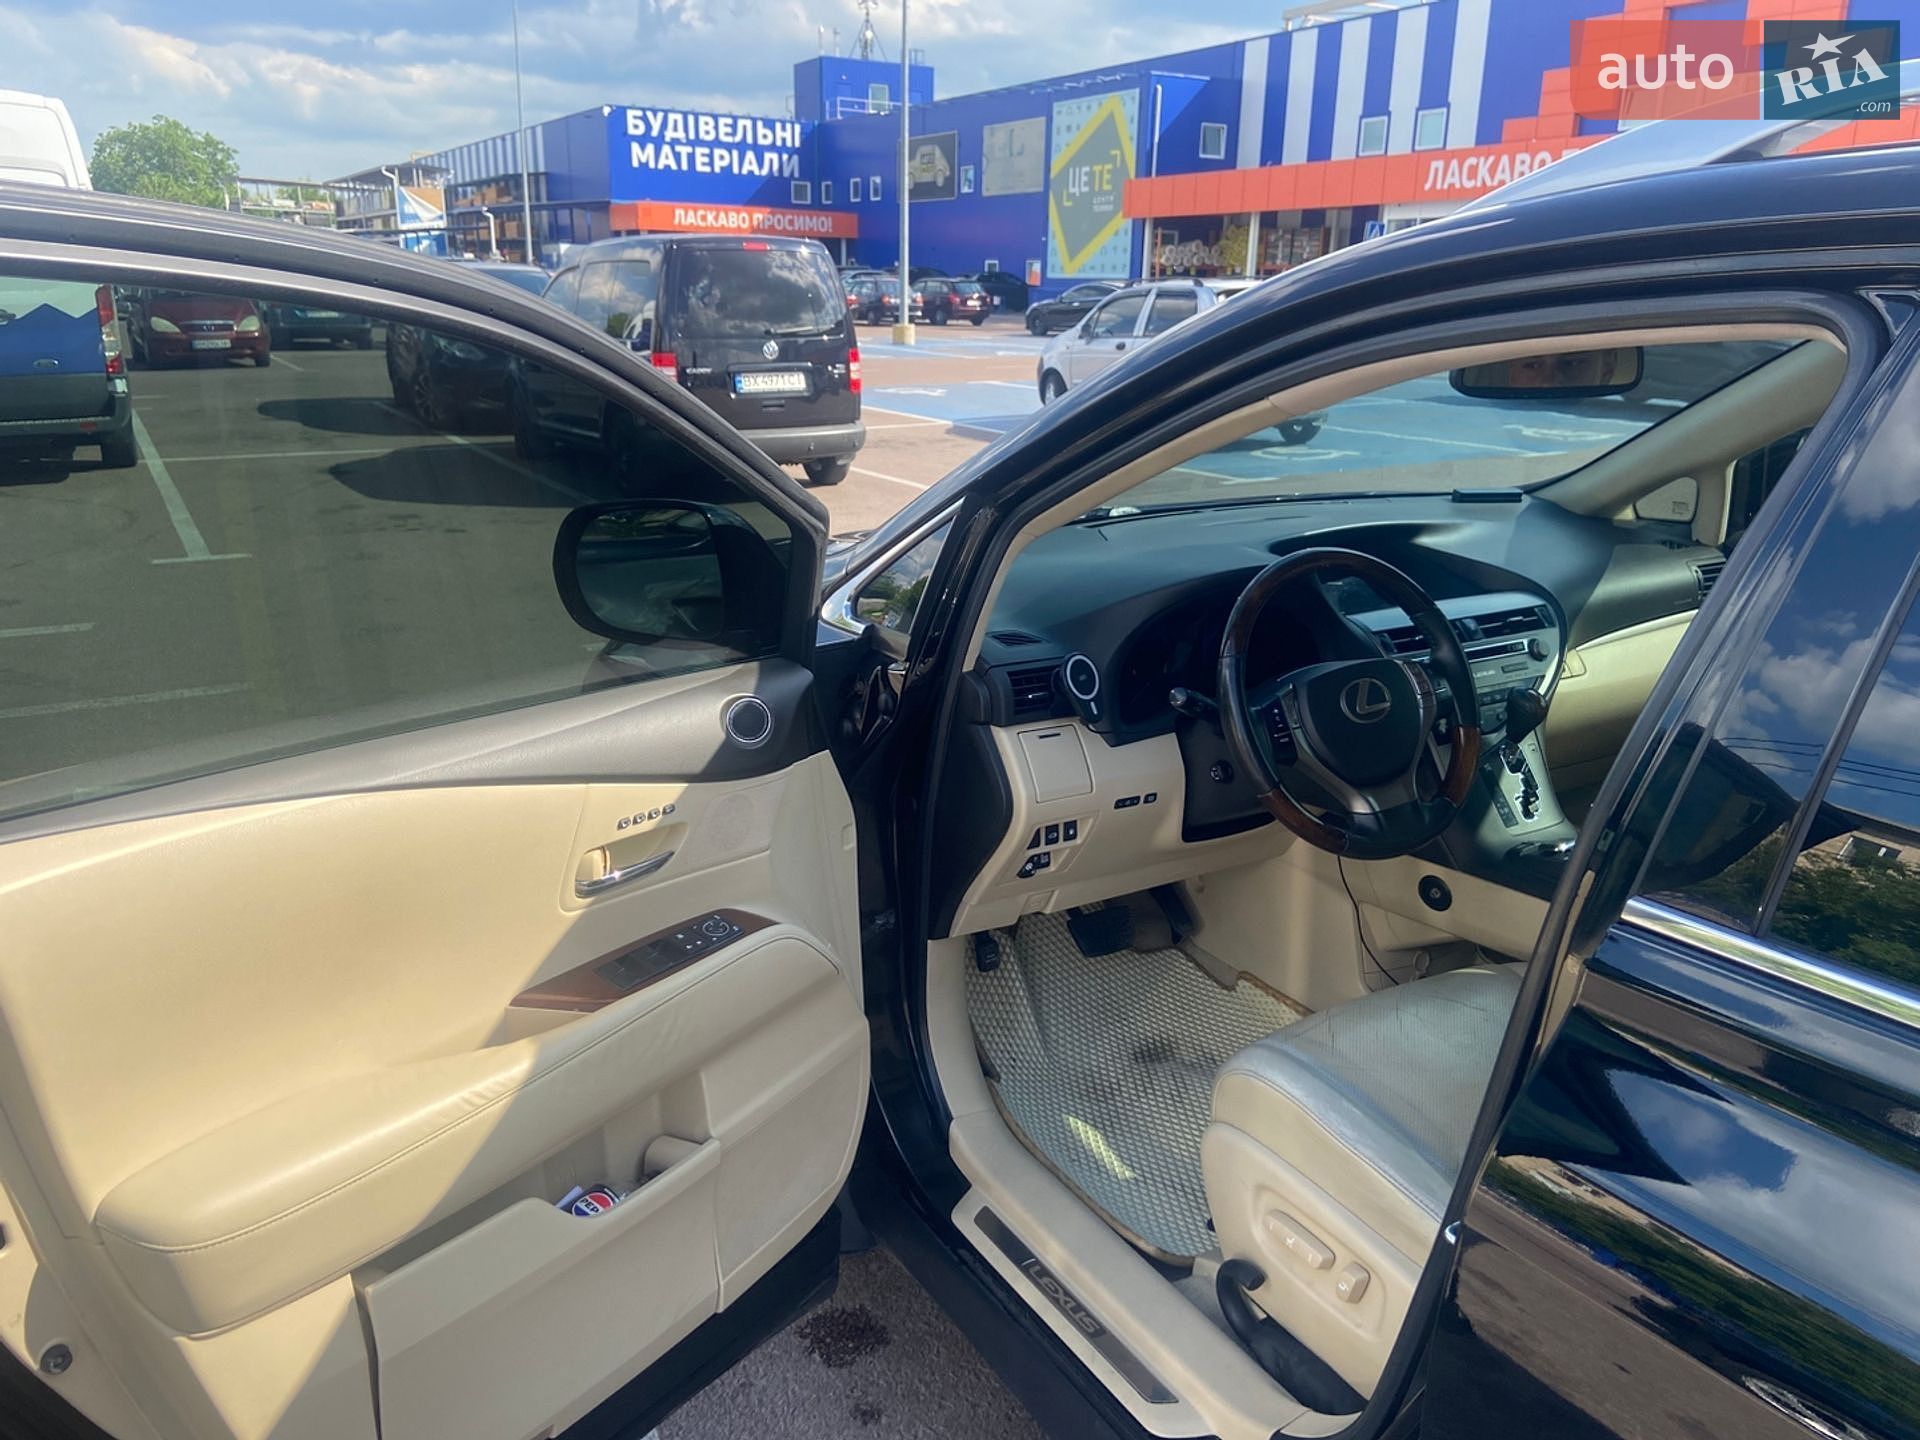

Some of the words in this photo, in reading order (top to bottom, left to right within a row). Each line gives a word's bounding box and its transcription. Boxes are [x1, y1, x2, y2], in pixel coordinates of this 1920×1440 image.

[626, 108, 801, 148] БУДІВЕЛЬНІ
[630, 141, 800, 178] МАТЕРІАЛИ
[673, 207, 749, 230] ЛАСКАВО
[752, 212, 833, 234] ПРОСИМО!
[1028, 1264, 1102, 1334] LEXUS
